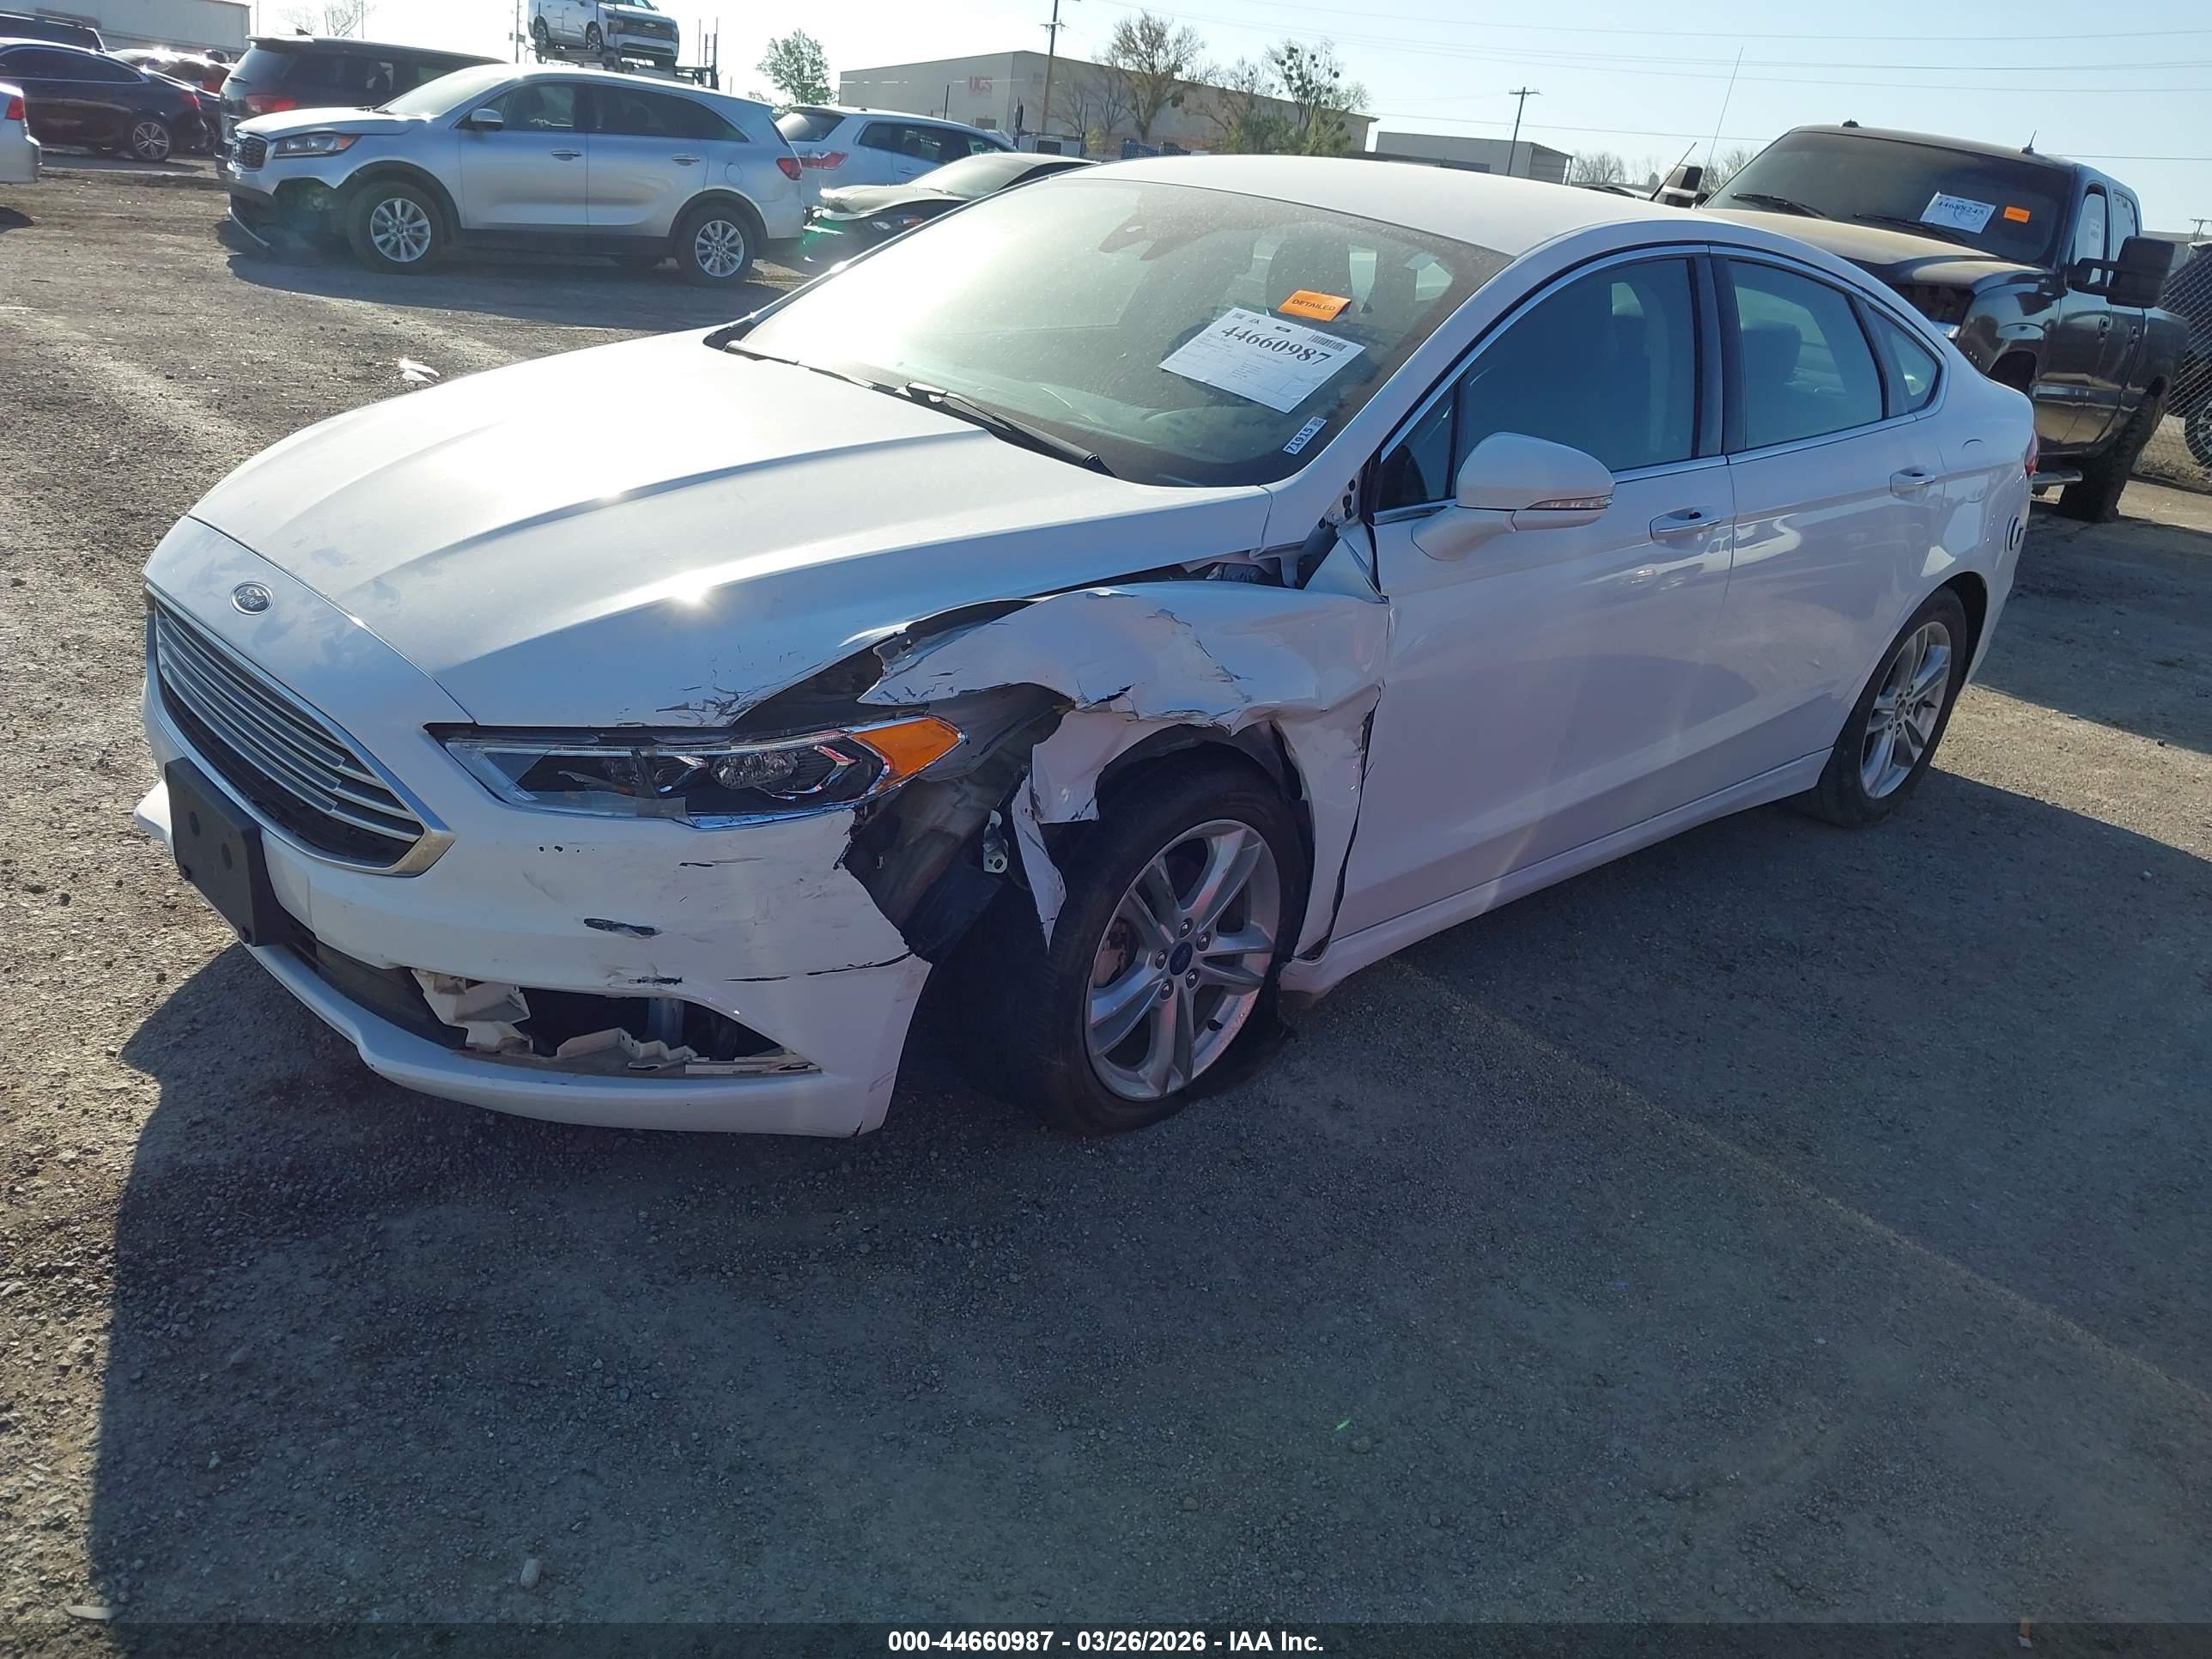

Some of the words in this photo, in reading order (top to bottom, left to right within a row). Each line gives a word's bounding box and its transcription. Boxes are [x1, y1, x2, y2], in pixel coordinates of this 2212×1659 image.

[1291, 299, 1336, 311] DETAILED
[1221, 325, 1332, 366] 44660987
[1285, 427, 1314, 453] 71915
